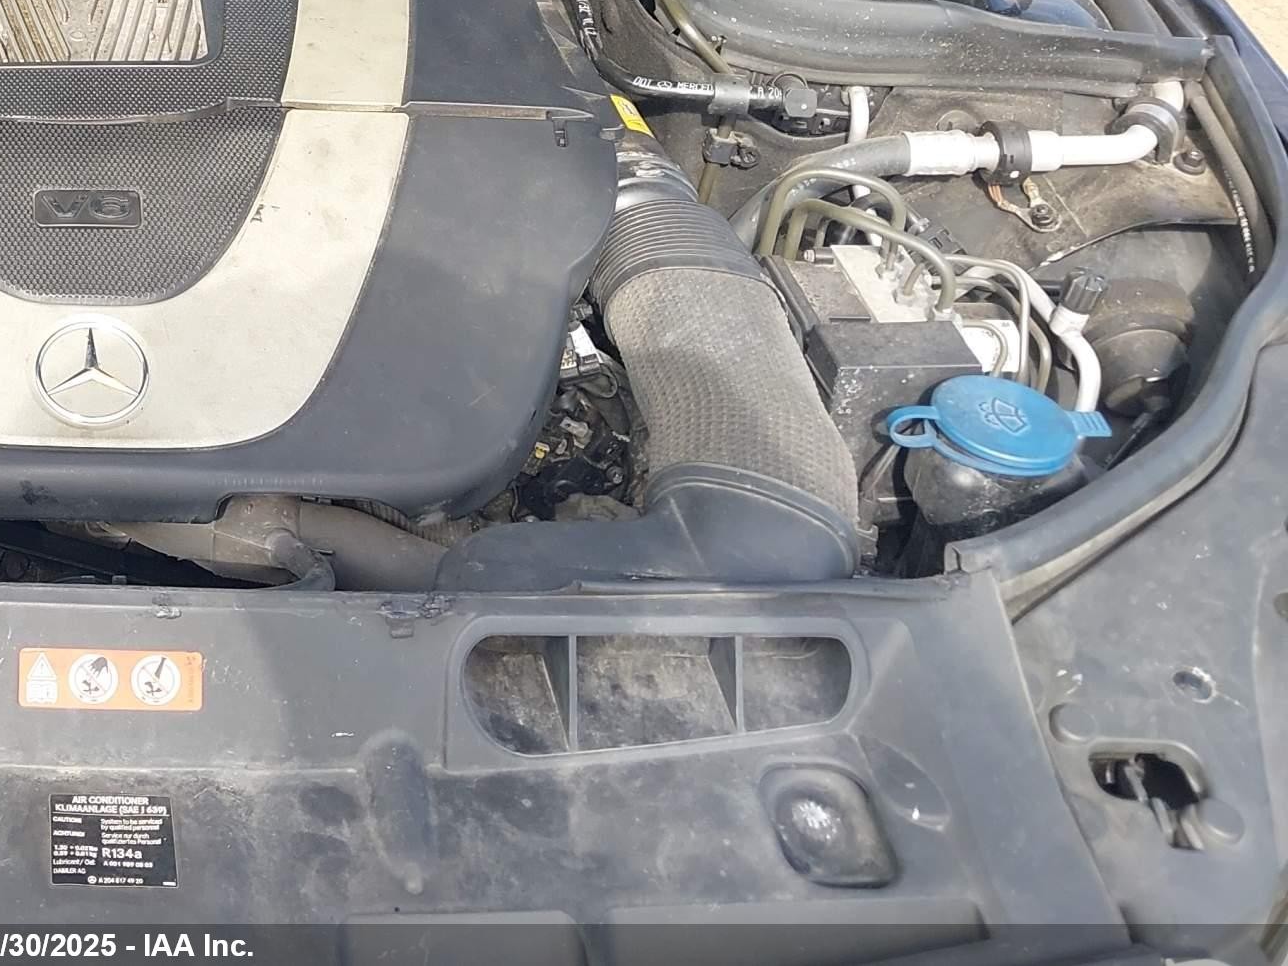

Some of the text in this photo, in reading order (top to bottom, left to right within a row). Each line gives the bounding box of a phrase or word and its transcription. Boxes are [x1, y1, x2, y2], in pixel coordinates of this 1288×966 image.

[40, 194, 131, 219] V6
[72, 796, 149, 805] AIR CONDITIONER
[55, 804, 117, 813] KLIMAANLAGE
[119, 805, 139, 815] (SAE
[146, 806, 167, 816] 639)
[101, 847, 143, 859] R134a
